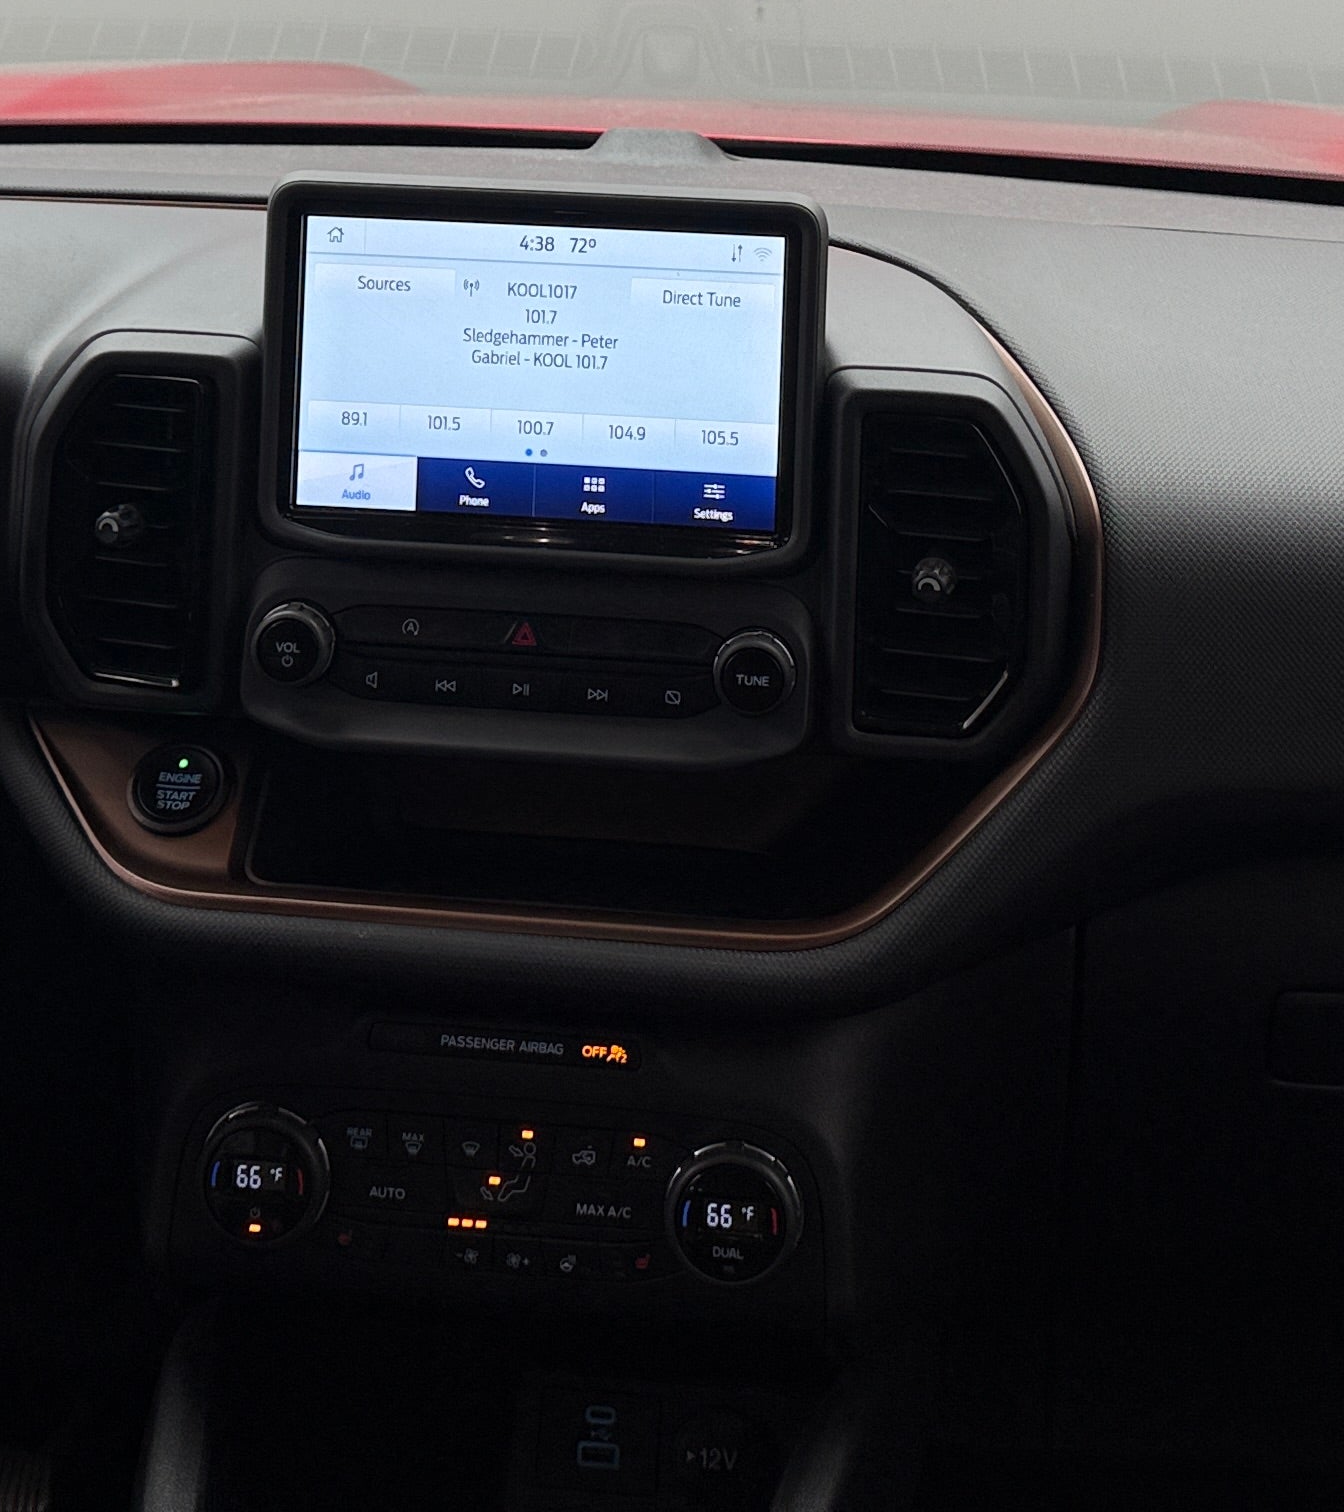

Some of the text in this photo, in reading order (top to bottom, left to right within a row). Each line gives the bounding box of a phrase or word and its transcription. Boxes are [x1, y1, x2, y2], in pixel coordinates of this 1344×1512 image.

[519, 235, 555, 253] 4:38
[357, 275, 411, 292] Sources
[507, 282, 578, 300] KOOL1017
[662, 289, 741, 308] Direct Tune
[525, 310, 557, 325] 101.7
[463, 328, 570, 349] Sledgehammer
[581, 334, 618, 350] Peter
[471, 350, 521, 367] Gabriel
[534, 353, 573, 369] KOOL
[575, 355, 608, 371] 101.7
[341, 411, 368, 427] 89.1
[427, 415, 461, 431] 101.5
[517, 420, 554, 436] 100.7
[608, 424, 646, 441] 104.9
[701, 430, 739, 446] 105.5
[342, 489, 371, 502] Audio
[459, 494, 489, 509] Phone
[581, 501, 606, 515] Apps
[694, 507, 733, 523] Settings
[275, 641, 301, 654] VOL
[735, 674, 770, 687] TUNE
[158, 772, 202, 784] ENGINE
[156, 790, 196, 801] START
[156, 799, 190, 810] STOP
[440, 1034, 608, 1059] PASSENGER AIRBAG OFF
[346, 1126, 372, 1137] REAR
[402, 1132, 425, 1142] MAX
[627, 1154, 651, 1169] A/C
[236, 1165, 262, 1189] 66
[369, 1185, 406, 1200] AUTO
[575, 1203, 632, 1220] MAX A/C
[706, 1203, 733, 1229] 66
[712, 1246, 744, 1261] DUAL
[701, 1448, 737, 1470] 12V
